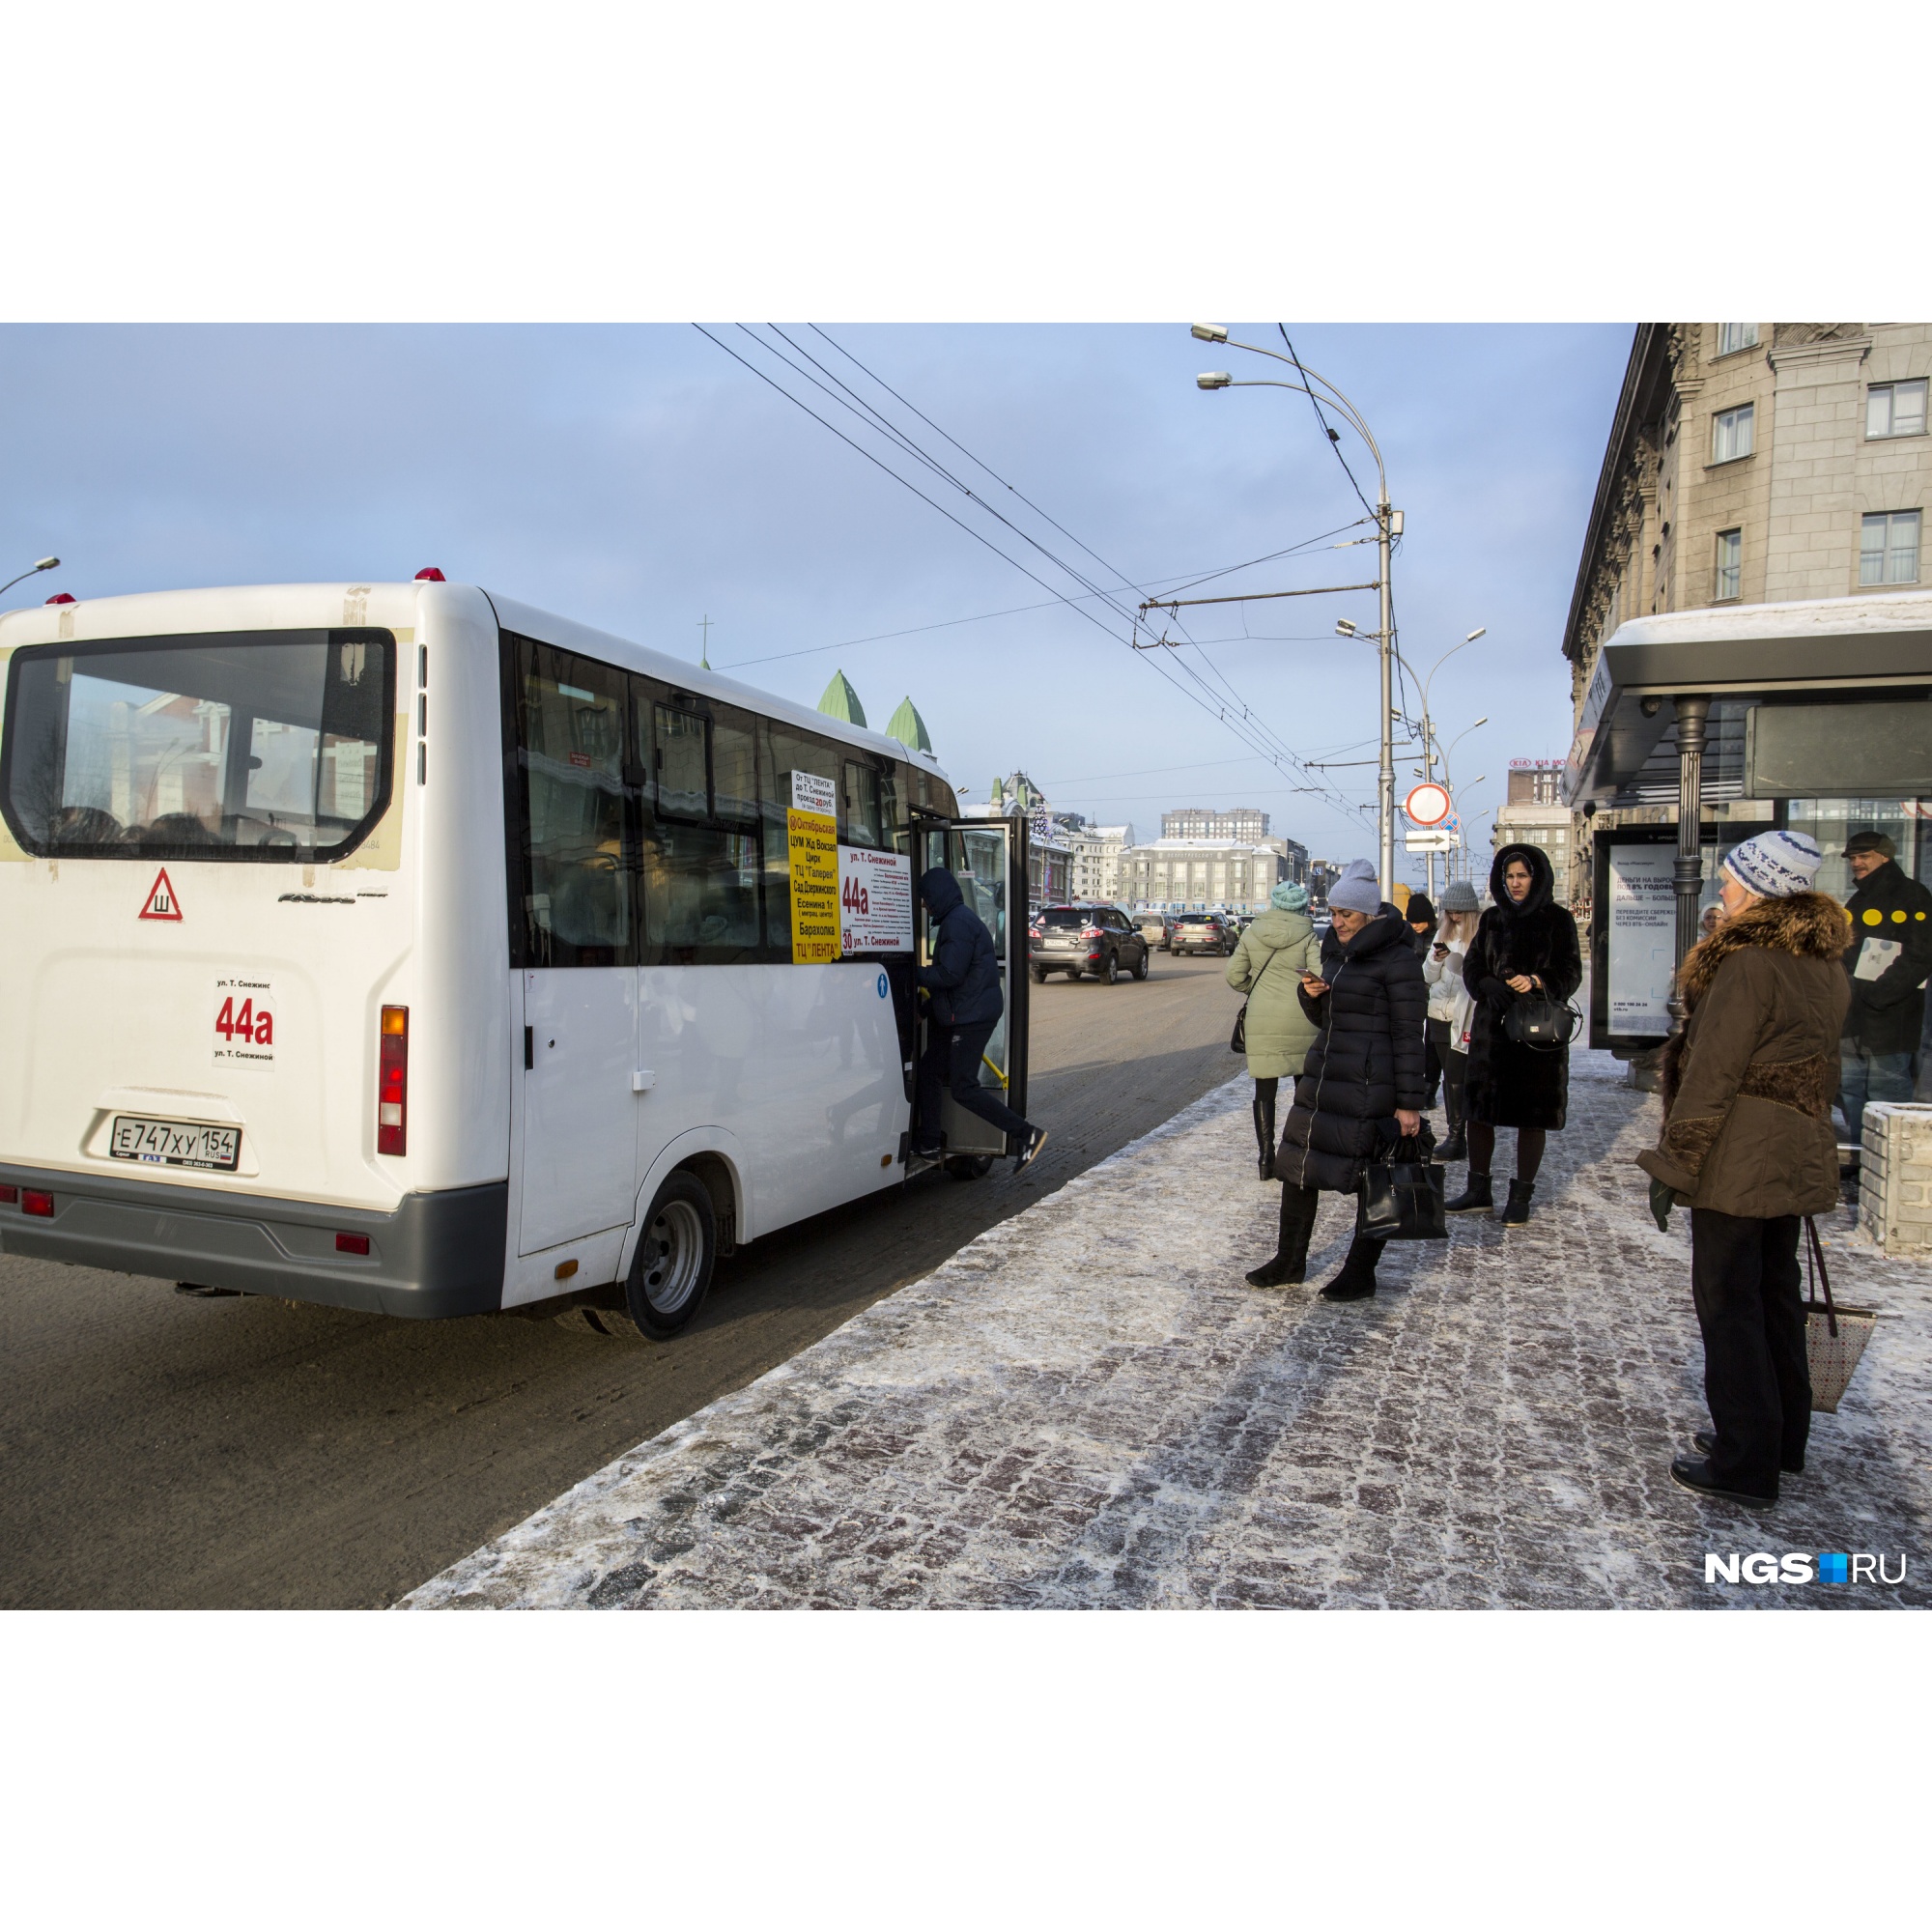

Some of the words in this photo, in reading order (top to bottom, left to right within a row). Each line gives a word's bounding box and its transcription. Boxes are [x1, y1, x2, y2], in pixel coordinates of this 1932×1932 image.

[804, 776, 811, 784] ТЦ
[812, 777, 832, 789] "ЛЕНТА"
[804, 784, 808, 793] Т.
[809, 786, 835, 798] Снежиной
[796, 794, 815, 804] проезд
[816, 797, 823, 807] 20
[823, 799, 833, 808] руб.
[797, 817, 835, 835] Октябрьская
[790, 835, 804, 849] ЦУМ
[805, 837, 816, 851] Жд
[817, 839, 837, 852] Вокзал
[806, 852, 821, 865] Цирк
[850, 853, 859, 863] ул.
[861, 852, 867, 862] Т.
[867, 853, 897, 867] Снежиной
[795, 865, 804, 878] ТЦ
[805, 866, 835, 881] "Галерея"
[794, 880, 804, 895] Сад
[842, 876, 869, 915] 44а
[154, 895, 169, 912] Ш
[797, 898, 825, 909] Есенина
[799, 922, 835, 939] Барахолка
[843, 933, 852, 950] 30
[854, 937, 863, 948] ул.
[864, 936, 870, 946] Т.
[871, 936, 900, 946] Снежиной
[796, 943, 807, 960] ТЦ
[215, 996, 273, 1045] 44а
[236, 1051, 273, 1061] Снежиной
[120, 1124, 197, 1155] Е747ХУ
[201, 1131, 230, 1152] 154
[143, 1154, 161, 1162] ГАЗ
[205, 1151, 220, 1159] RUS
